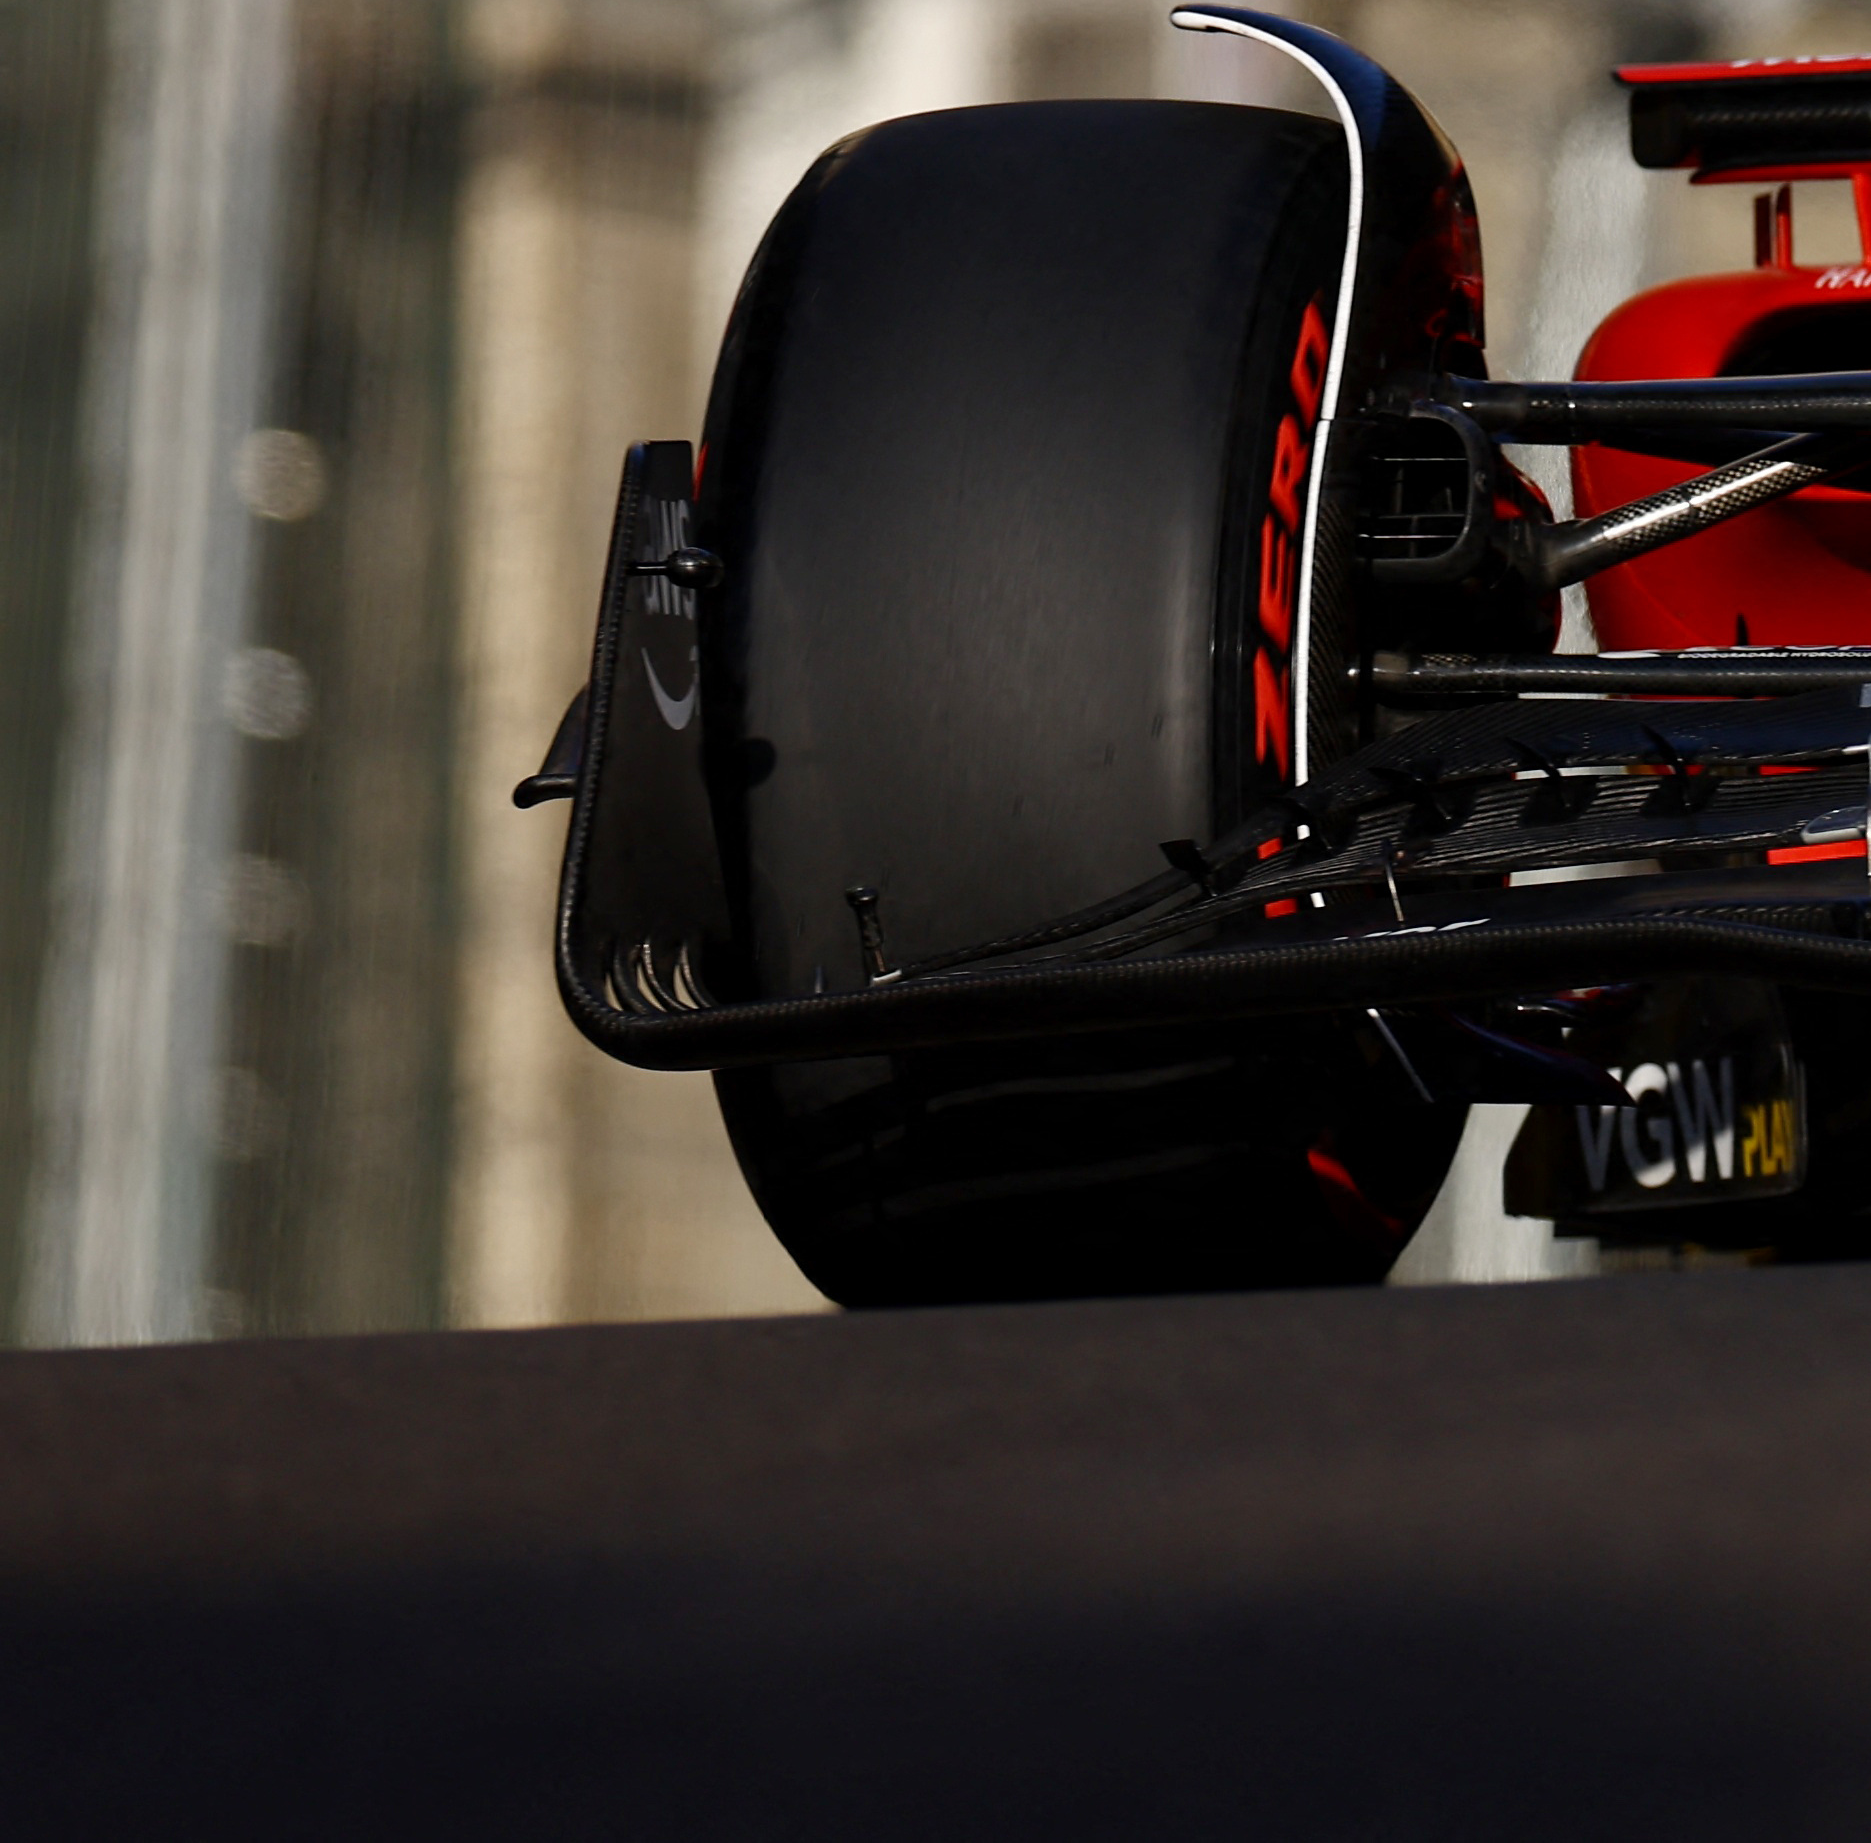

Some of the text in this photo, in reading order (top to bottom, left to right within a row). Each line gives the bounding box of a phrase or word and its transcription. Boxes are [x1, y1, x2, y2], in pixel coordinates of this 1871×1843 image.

[1253, 289, 1329, 783] ZERO
[1576, 1056, 1793, 1192] VGW PLA
